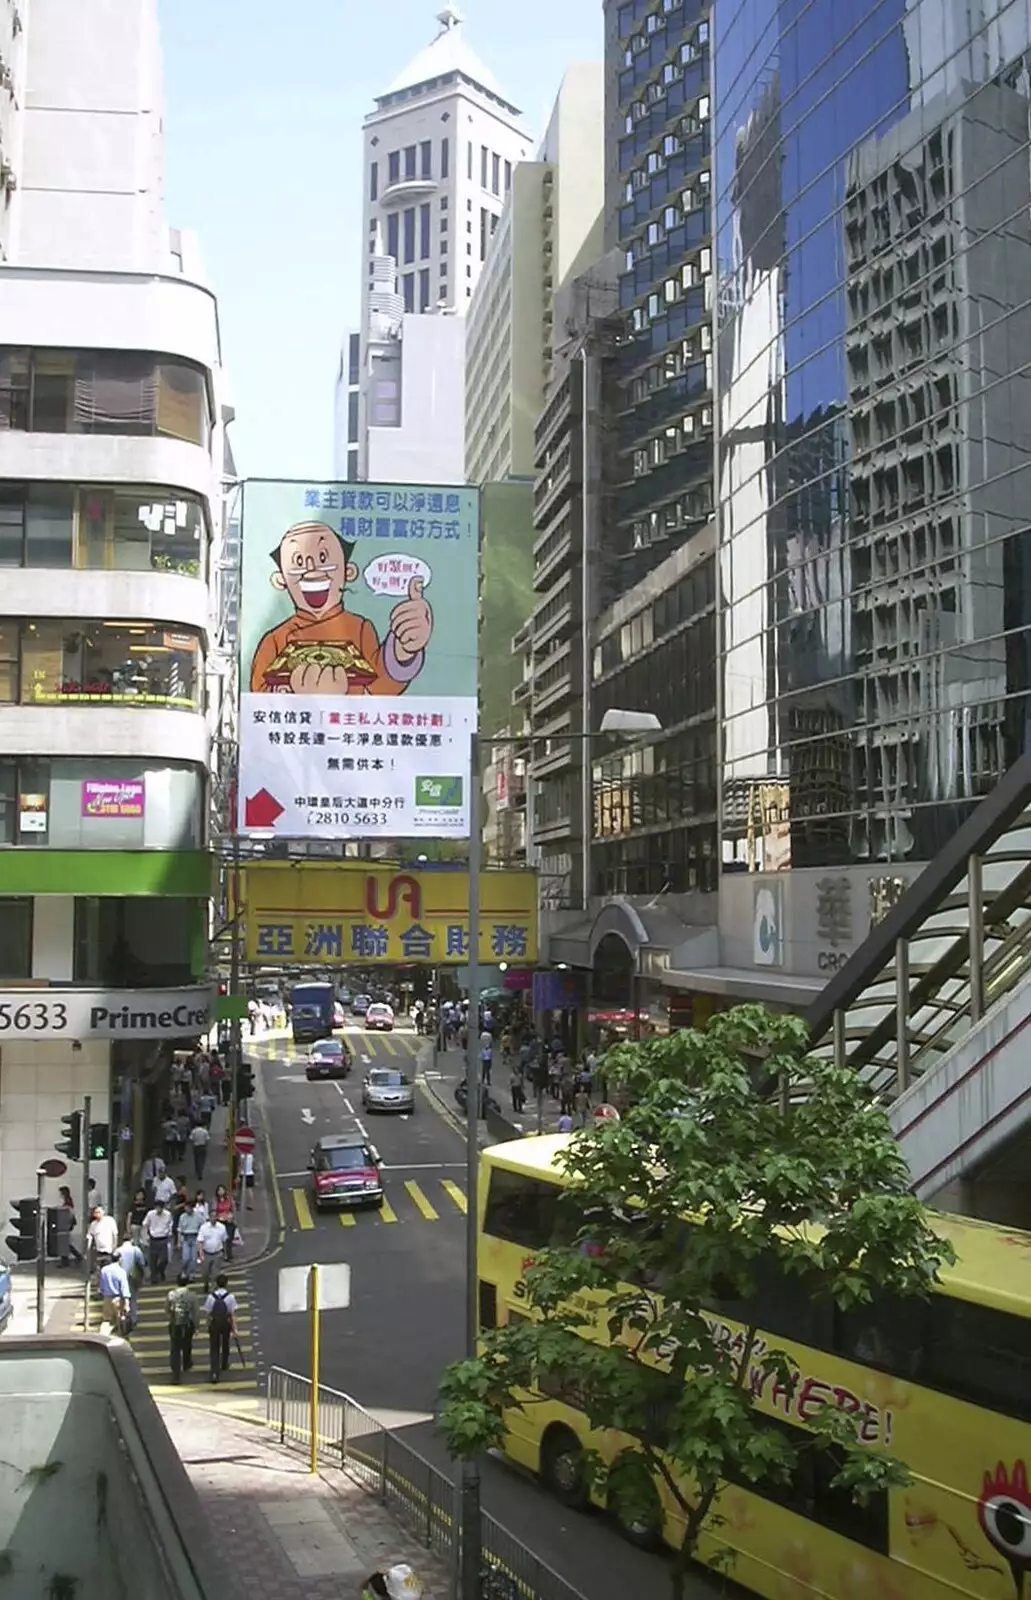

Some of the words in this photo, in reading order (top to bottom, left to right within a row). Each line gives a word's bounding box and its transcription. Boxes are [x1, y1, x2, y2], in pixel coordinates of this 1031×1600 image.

[294, 796, 405, 809] 中環皇后大道中分行
[316, 812, 349, 825] 2810
[352, 812, 387, 825] 5633
[256, 924, 529, 957] 亞洲聯合財務
[0, 1003, 68, 1030] 5633
